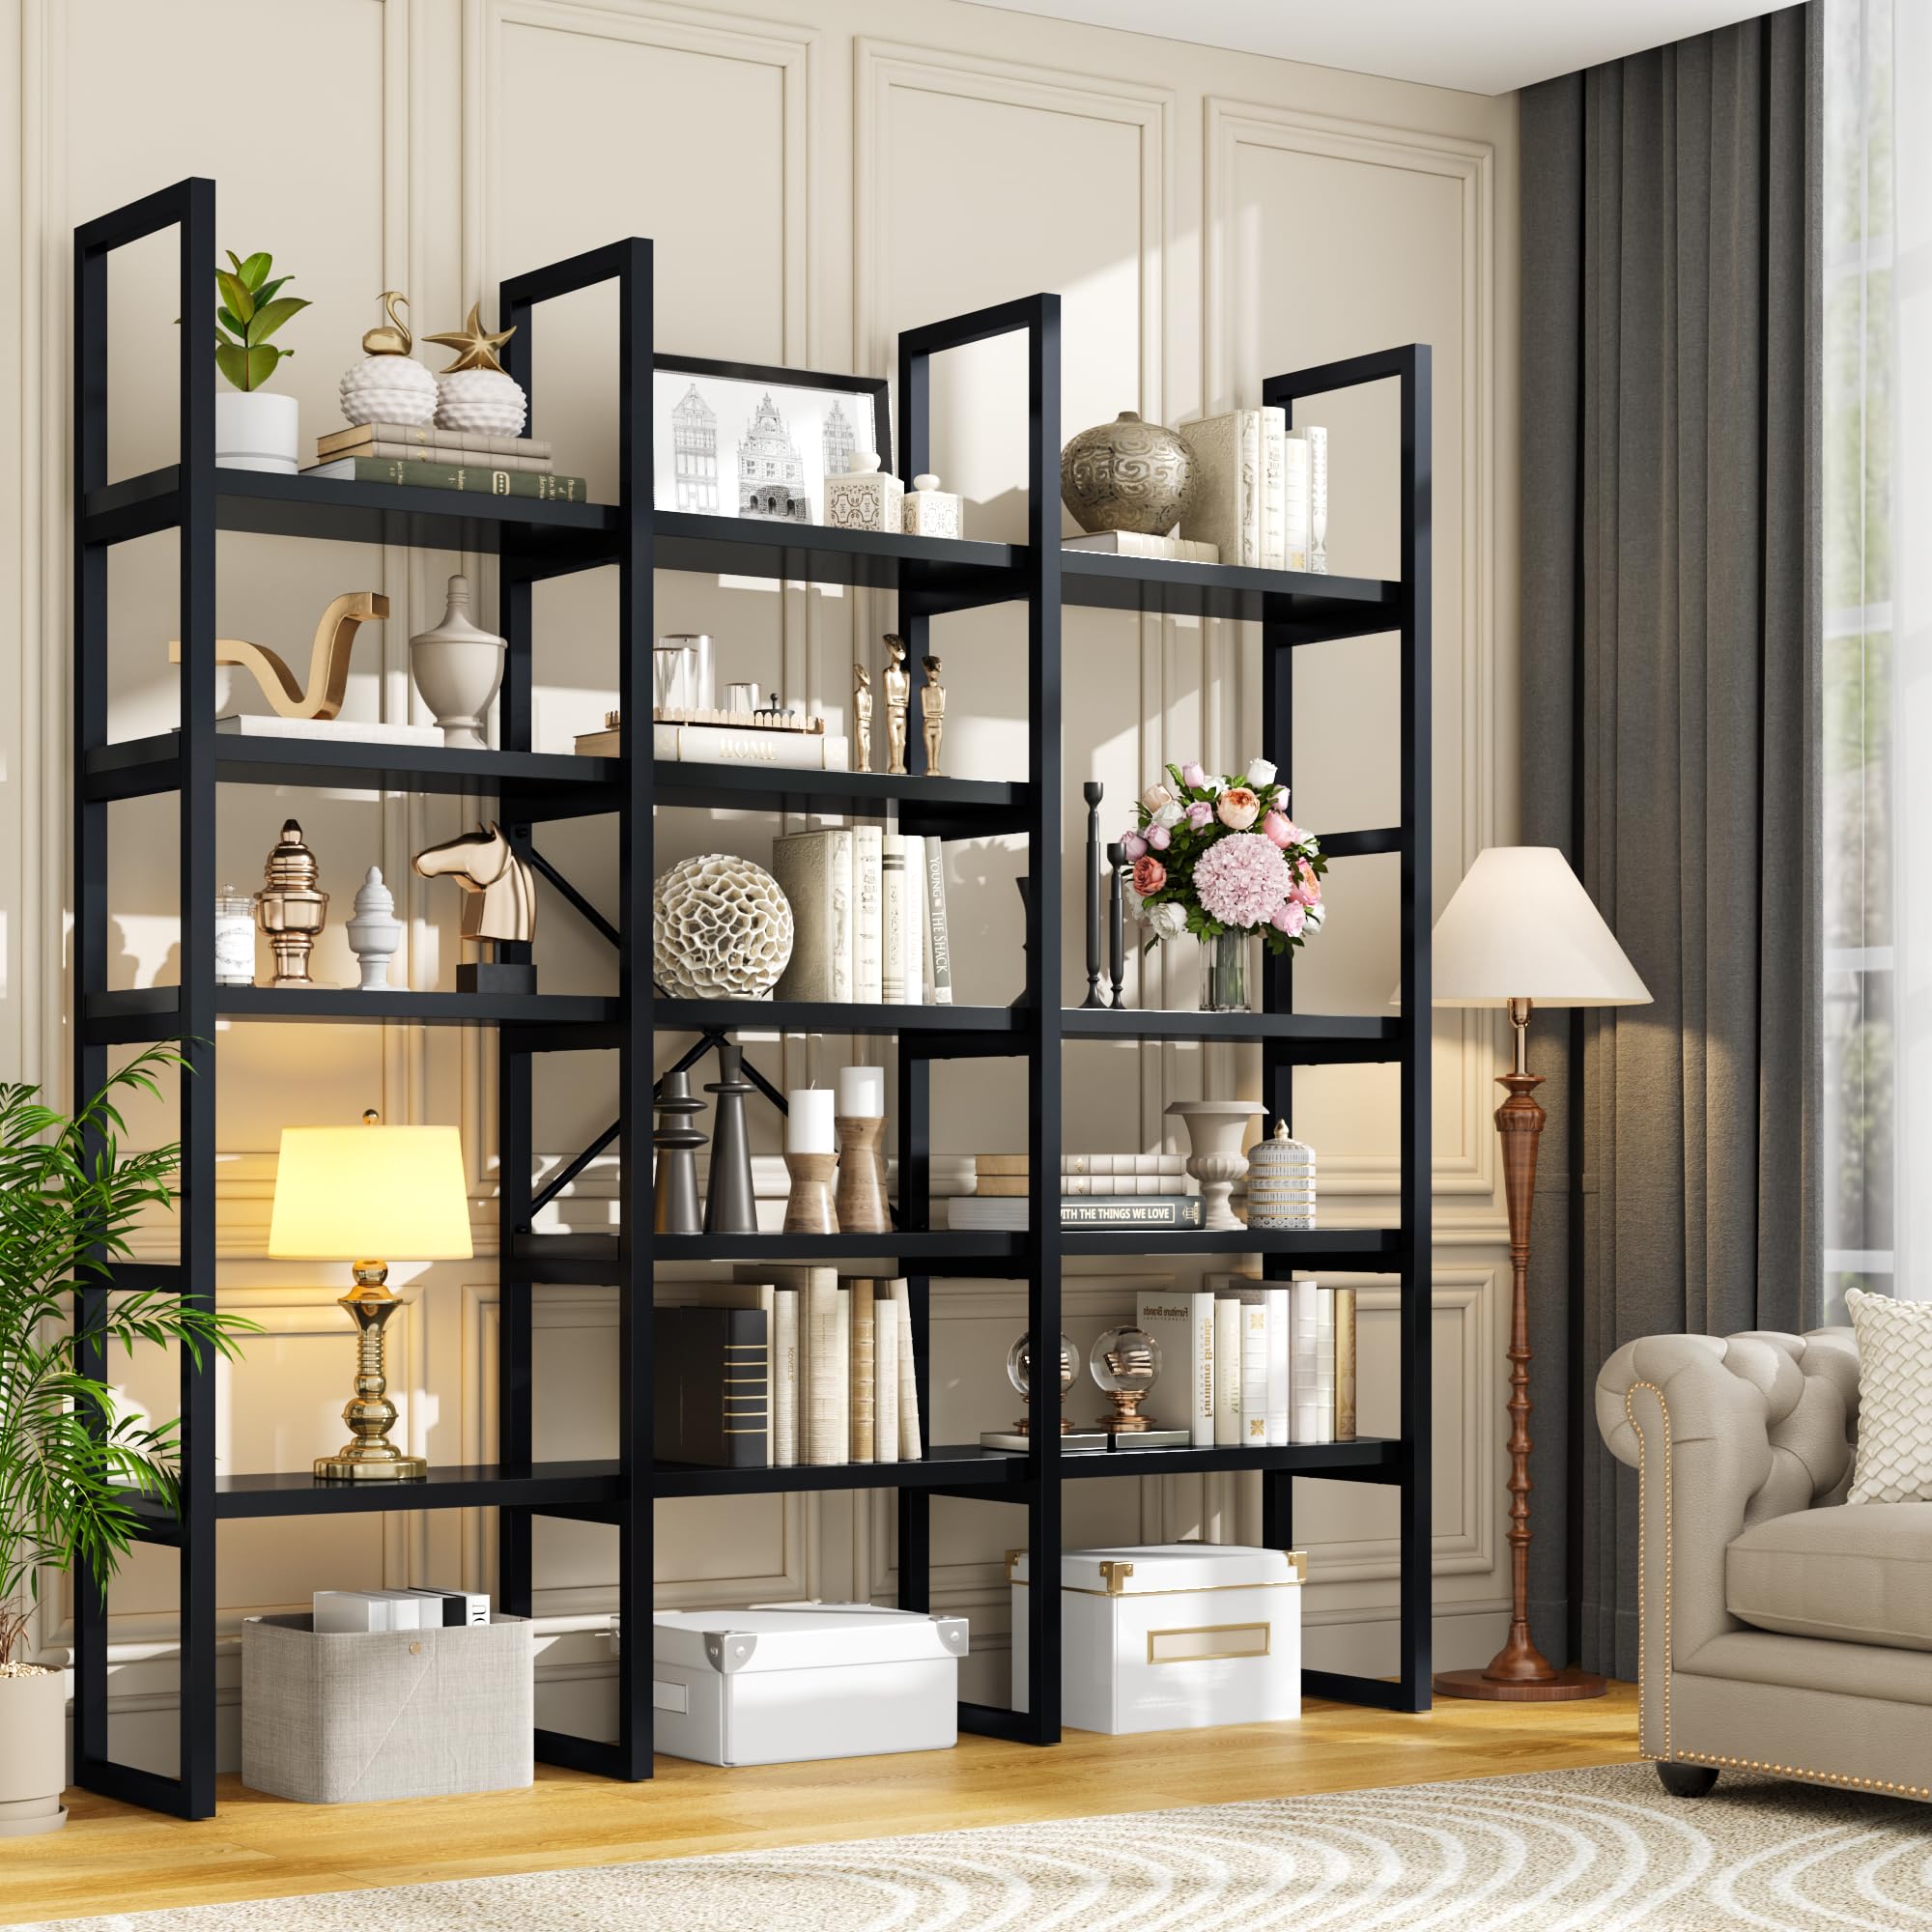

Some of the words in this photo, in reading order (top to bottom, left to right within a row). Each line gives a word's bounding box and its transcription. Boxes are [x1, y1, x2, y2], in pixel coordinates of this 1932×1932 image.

[929, 857, 942, 897] YOUNG
[931, 911, 945, 932] THE
[933, 935, 948, 974] SHACK
[1079, 1208, 1096, 1219] THE
[1097, 1208, 1130, 1219] THINGS
[1131, 1208, 1147, 1219] WE
[1148, 1208, 1170, 1219] LOVE
